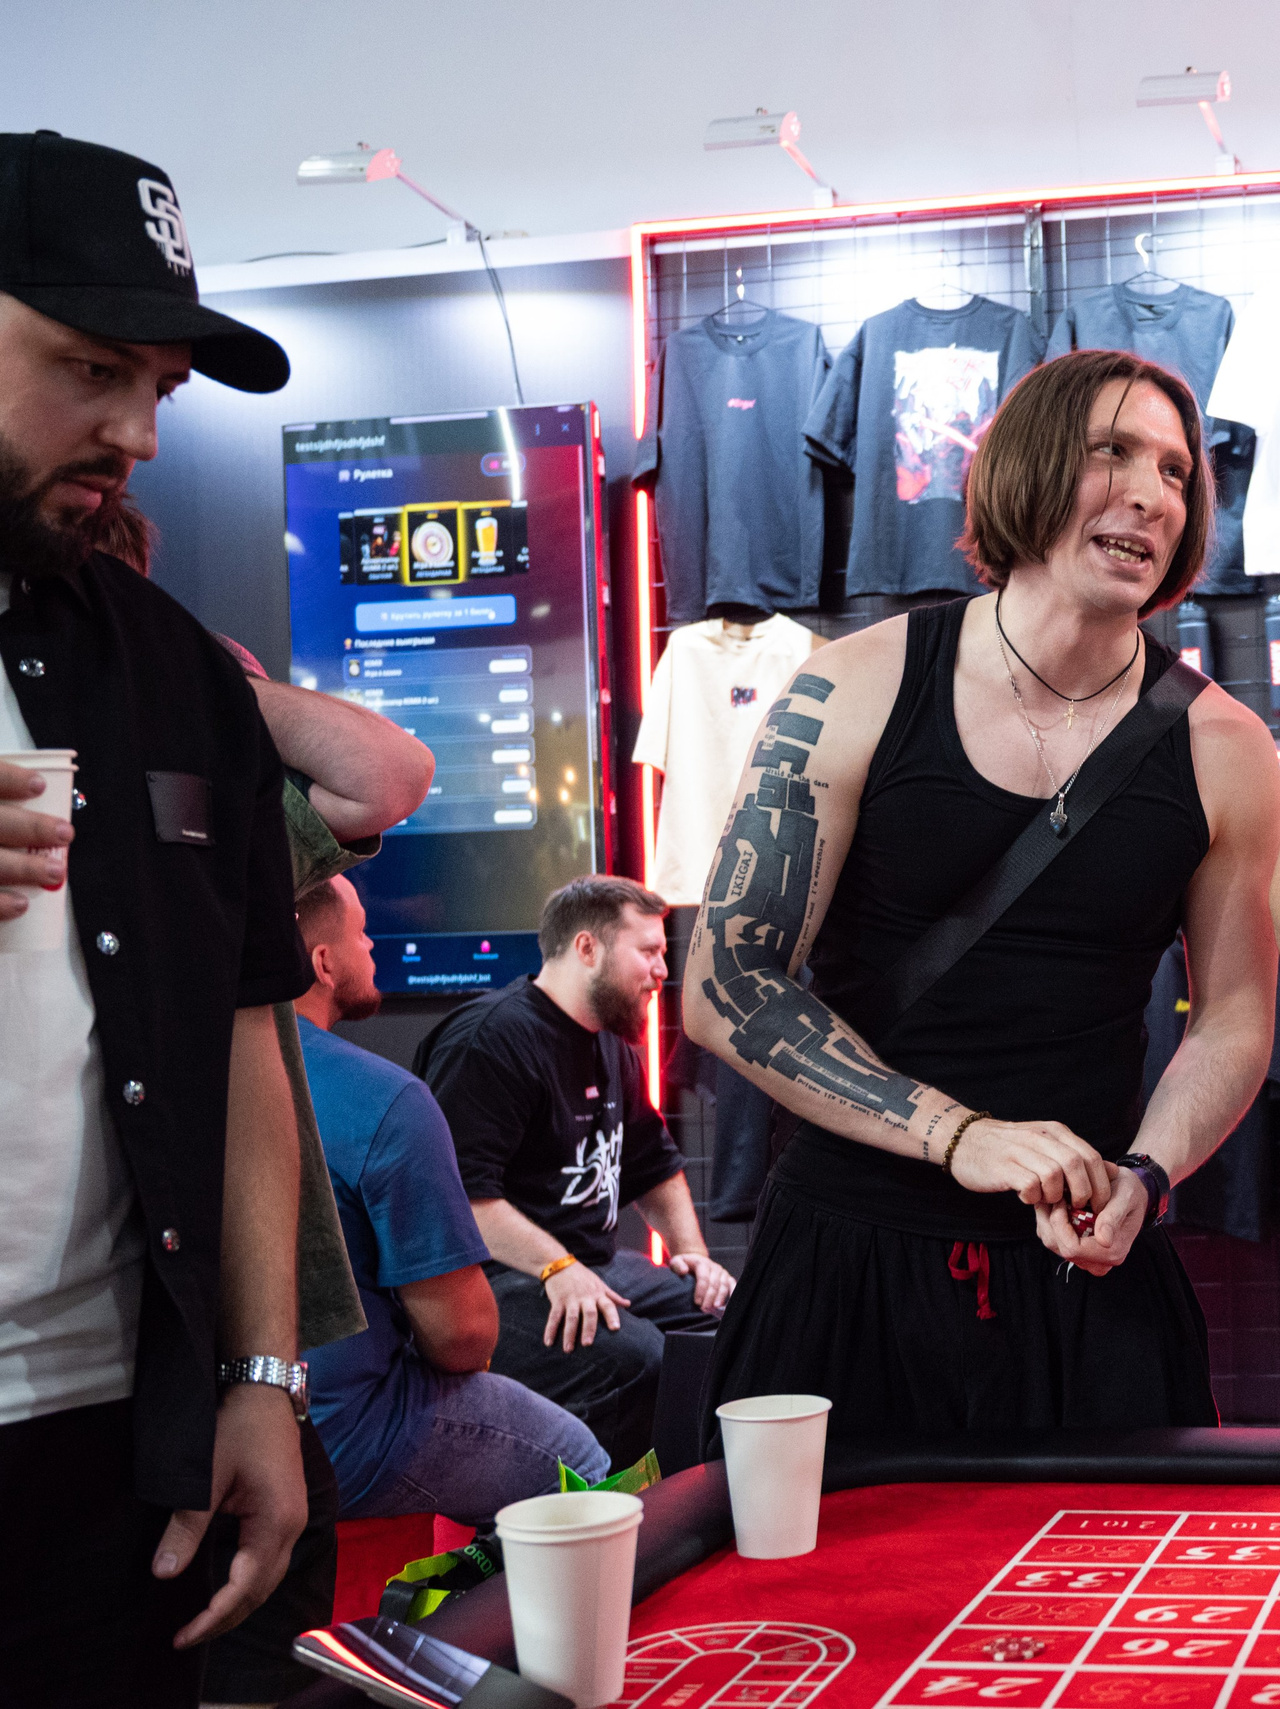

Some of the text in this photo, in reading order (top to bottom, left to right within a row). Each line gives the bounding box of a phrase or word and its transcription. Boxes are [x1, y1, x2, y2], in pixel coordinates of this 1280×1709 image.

[353, 468, 393, 483] Рулетка
[798, 773, 810, 783] the
[813, 780, 829, 789] dark
[814, 838, 826, 879] searching
[731, 850, 753, 897] IKIGAI
[797, 1078, 821, 1095] behind
[873, 1112, 882, 1120] to
[884, 1117, 909, 1132] Trying
[926, 1114, 942, 1136] will
[1080, 1520, 1156, 1530] 2 to 1
[1208, 1521, 1218, 1531] 1
[1231, 1521, 1258, 1530] to
[1015, 1570, 1126, 1588] 33
[986, 1602, 1104, 1621] 30
[1134, 1604, 1249, 1624] 29
[1106, 1638, 1233, 1659] 26
[920, 1675, 1044, 1699] 24
